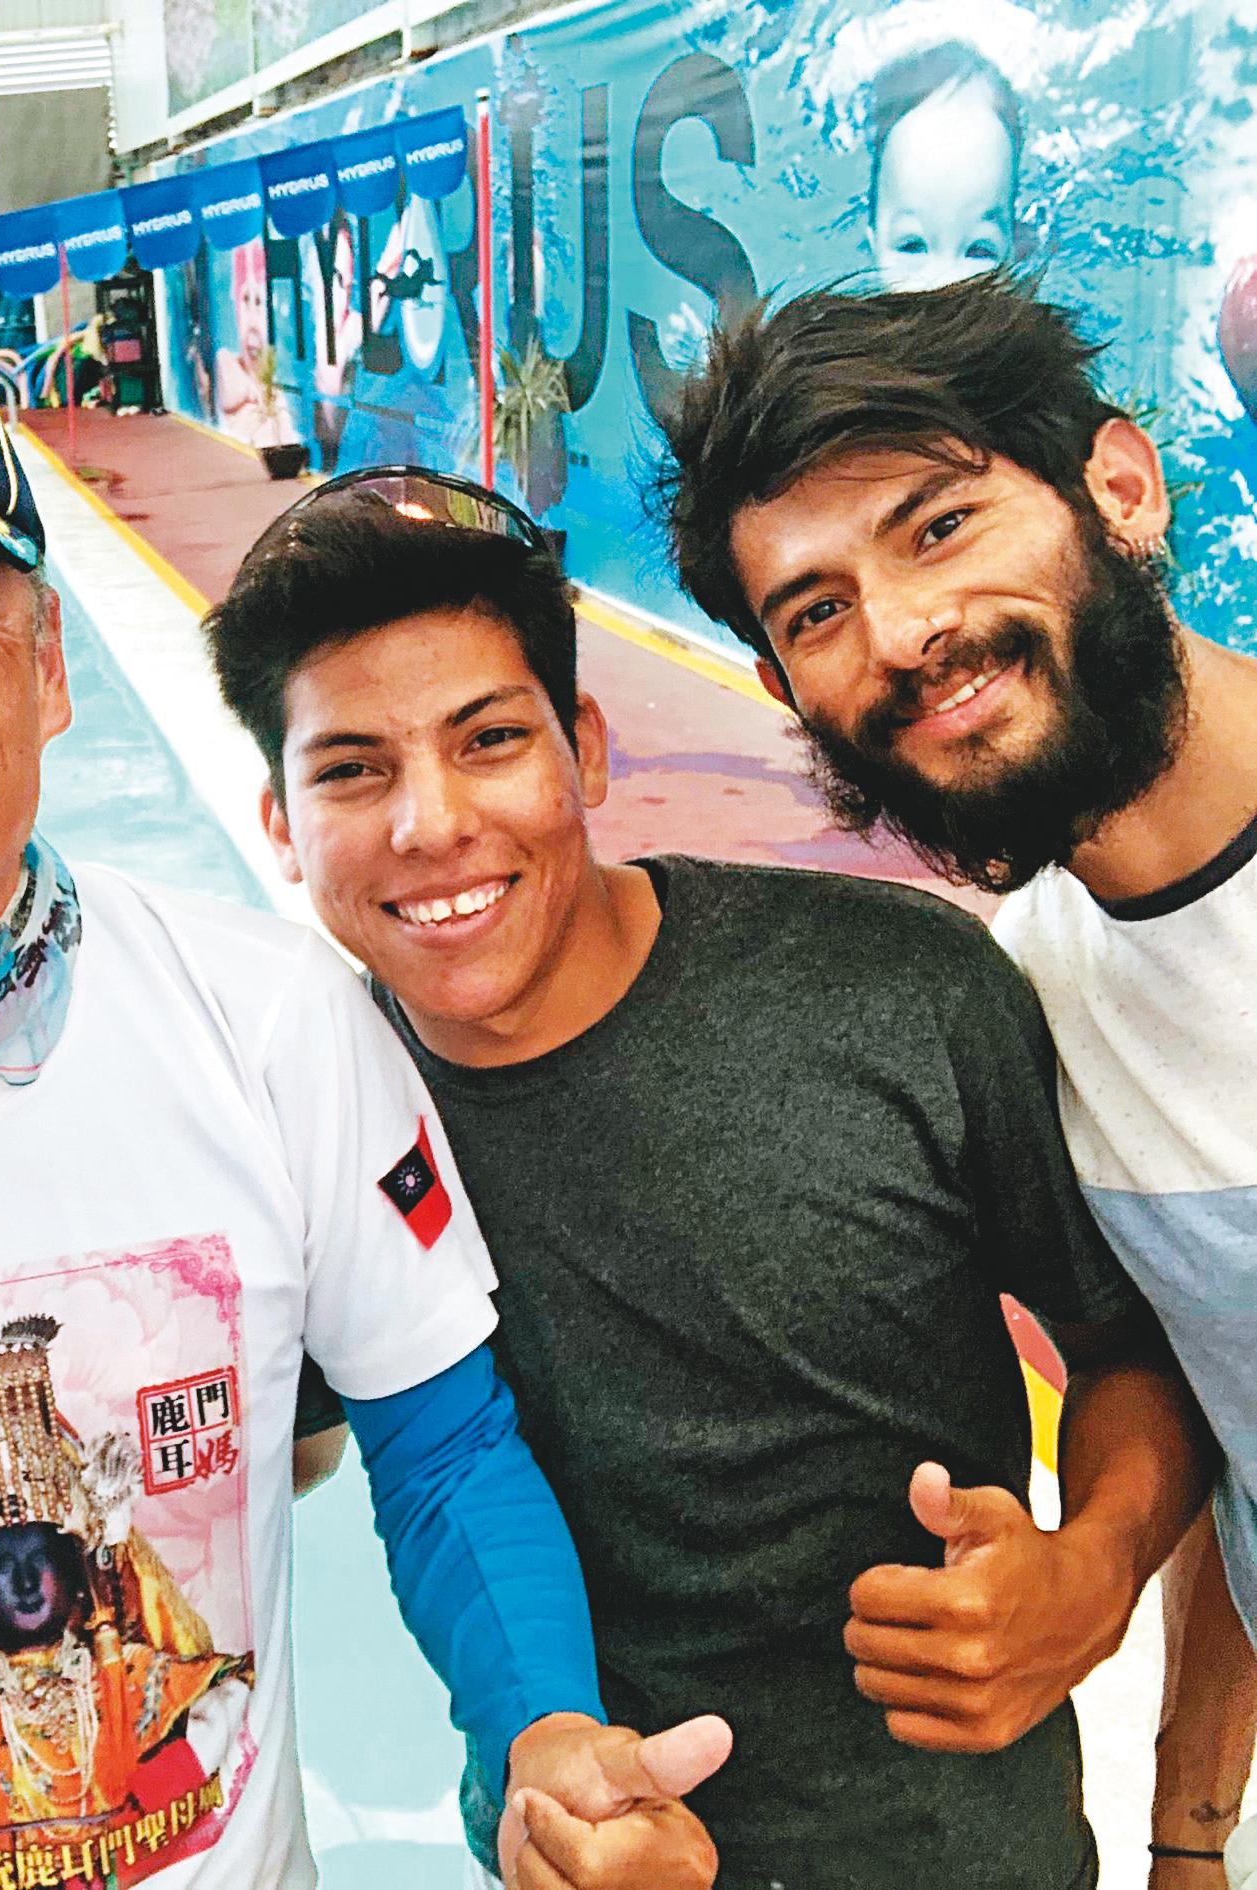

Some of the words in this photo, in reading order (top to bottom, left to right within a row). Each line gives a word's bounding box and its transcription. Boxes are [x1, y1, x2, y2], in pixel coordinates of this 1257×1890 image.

[64, 224, 123, 250] HYDRUS
[132, 209, 192, 236] HYDRUS
[201, 193, 261, 219] HYDRUS
[268, 173, 329, 199] HYDRUS
[337, 155, 396, 182] HYDRUS
[406, 138, 464, 165] HYDRUS
